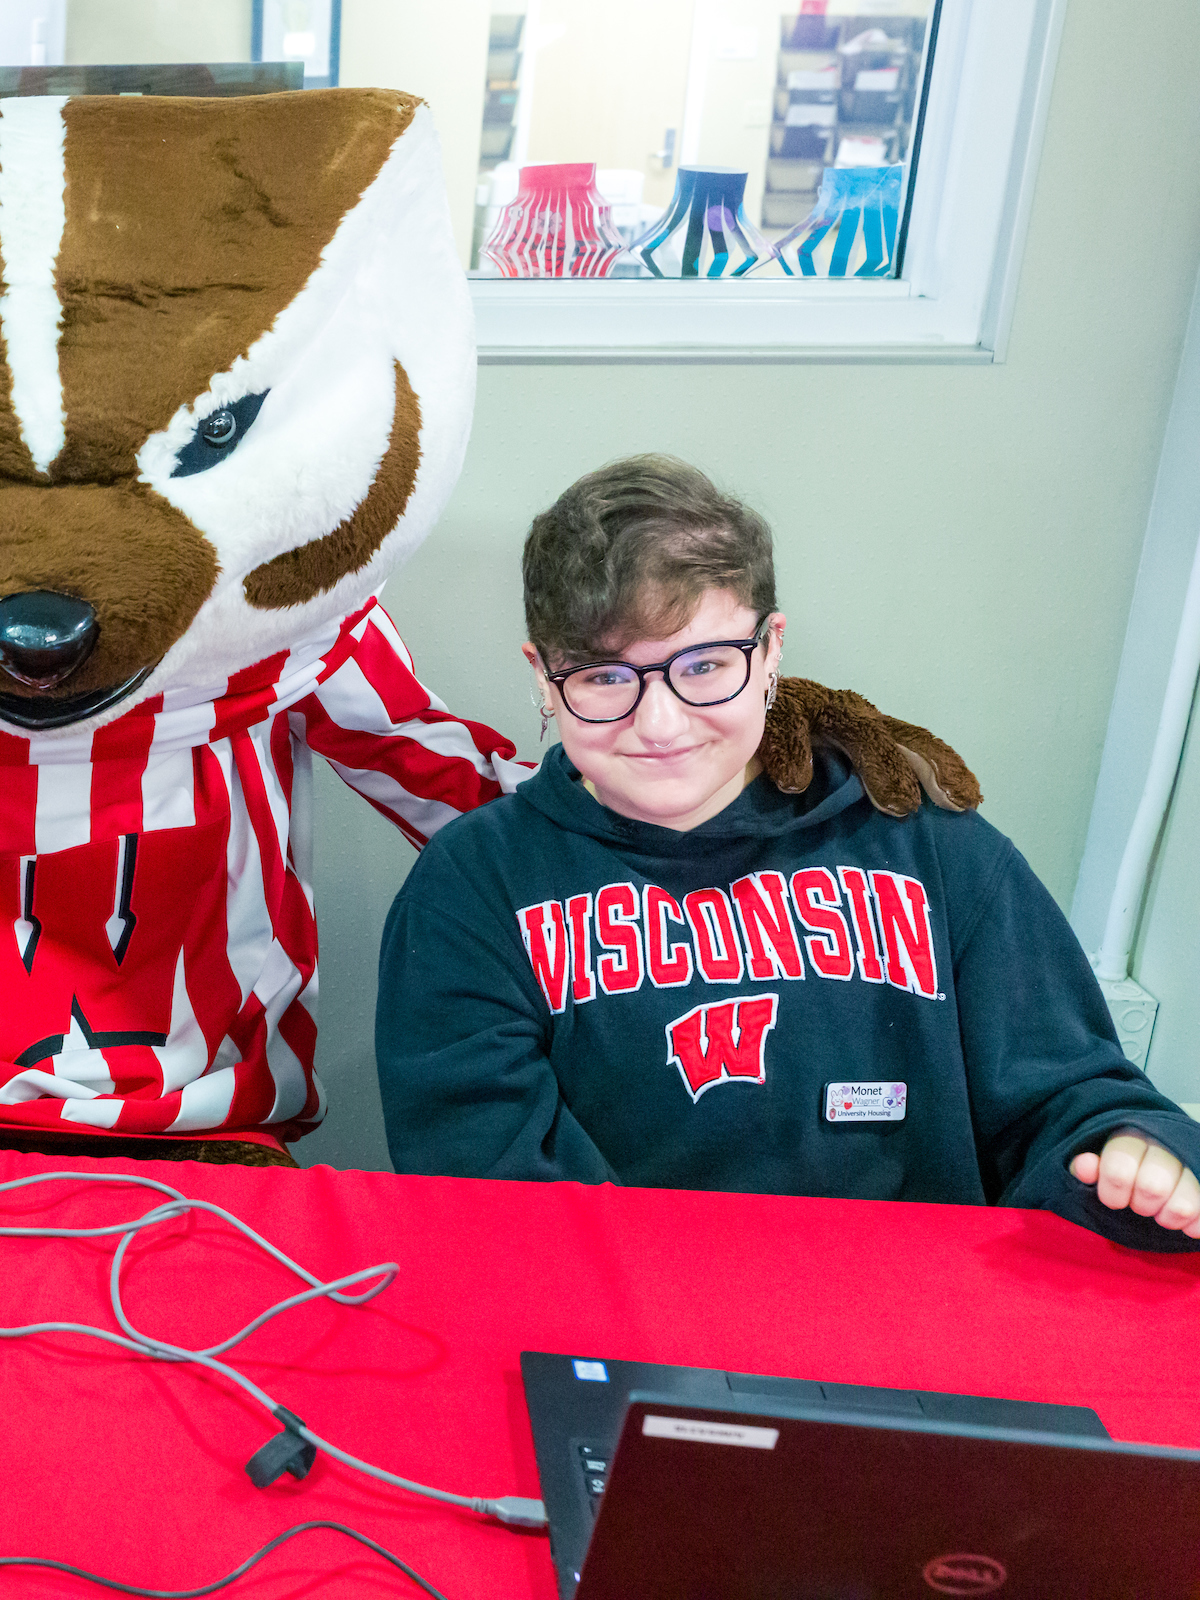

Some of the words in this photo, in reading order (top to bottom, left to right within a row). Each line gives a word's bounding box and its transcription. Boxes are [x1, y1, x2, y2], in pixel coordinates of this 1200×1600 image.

[515, 865, 939, 1015] WISCONSIN
[664, 993, 780, 1104] W
[851, 1086, 882, 1095] Monet
[852, 1098, 880, 1106] Wagner
